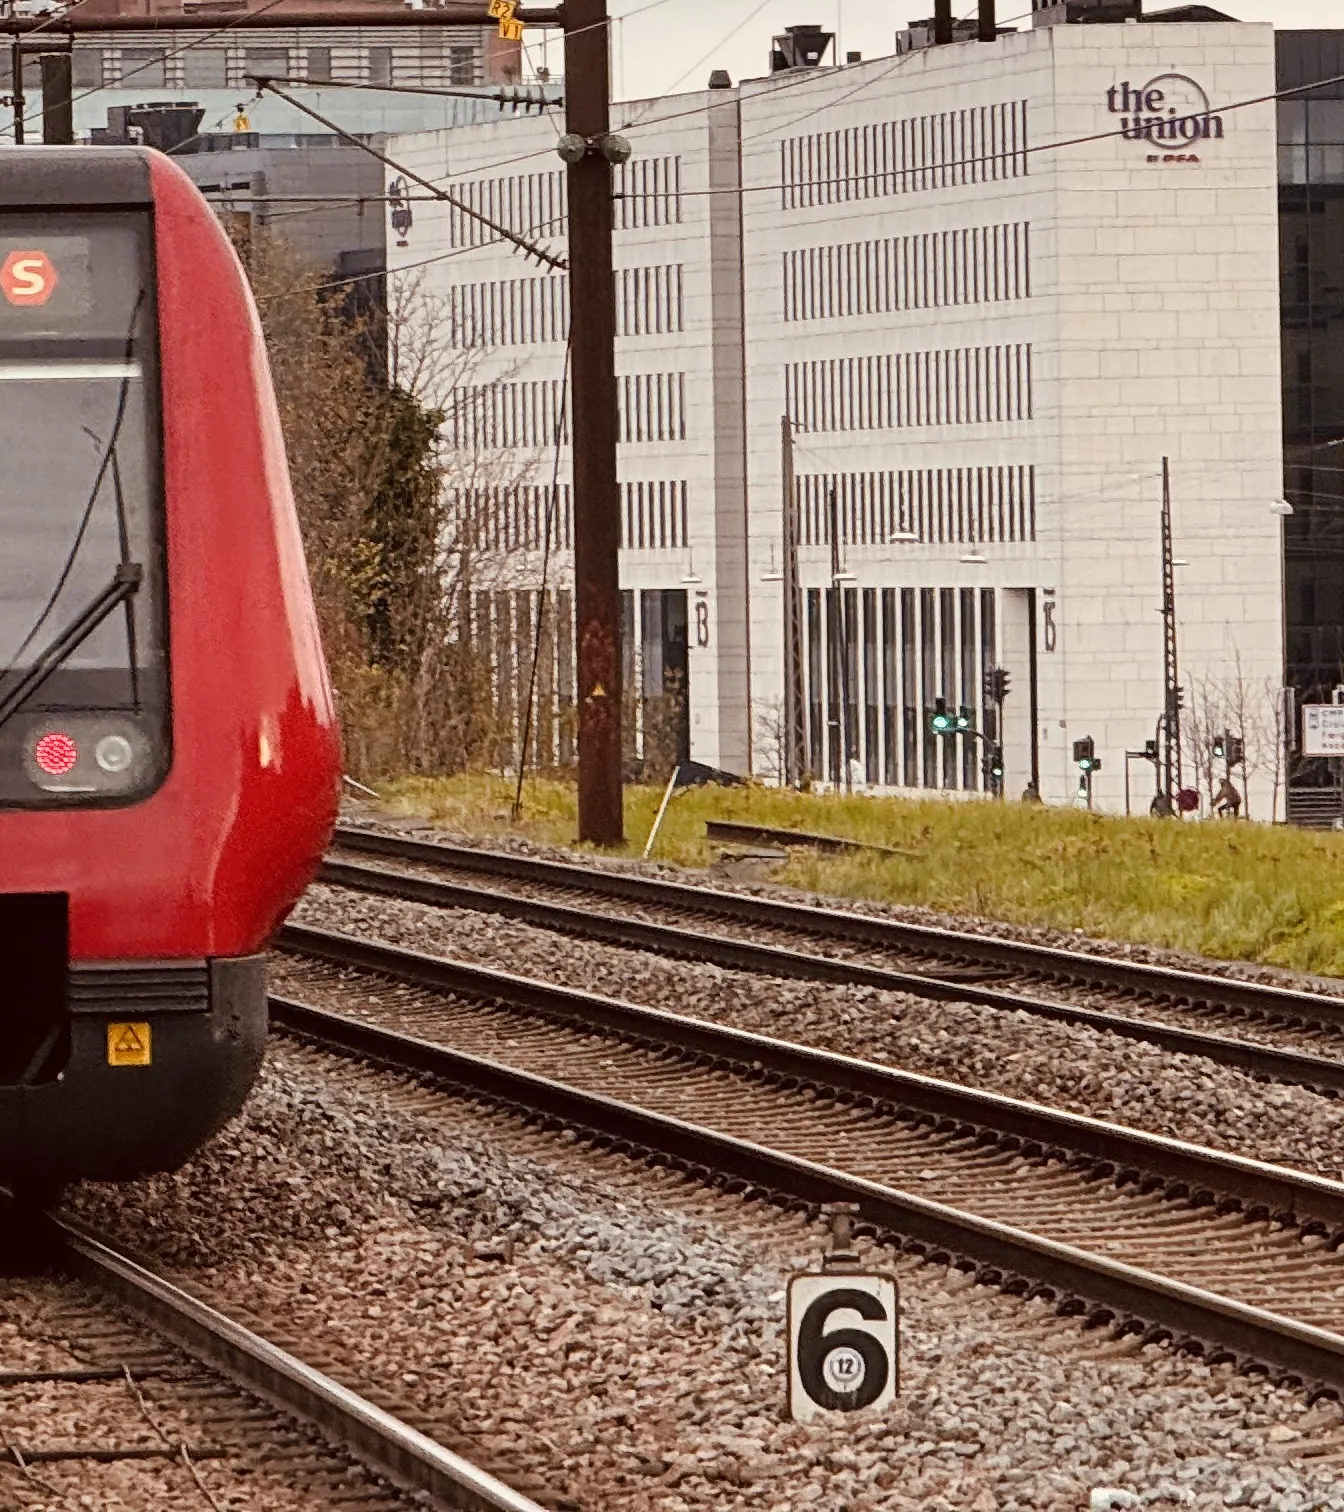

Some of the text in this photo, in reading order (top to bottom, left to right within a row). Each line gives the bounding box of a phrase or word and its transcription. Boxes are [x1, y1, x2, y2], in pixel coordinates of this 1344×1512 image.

[492, 0, 511, 20] R2
[1106, 81, 1165, 113] the
[1120, 107, 1224, 140] union
[12, 259, 44, 295] S
[798, 1288, 889, 1413] 6
